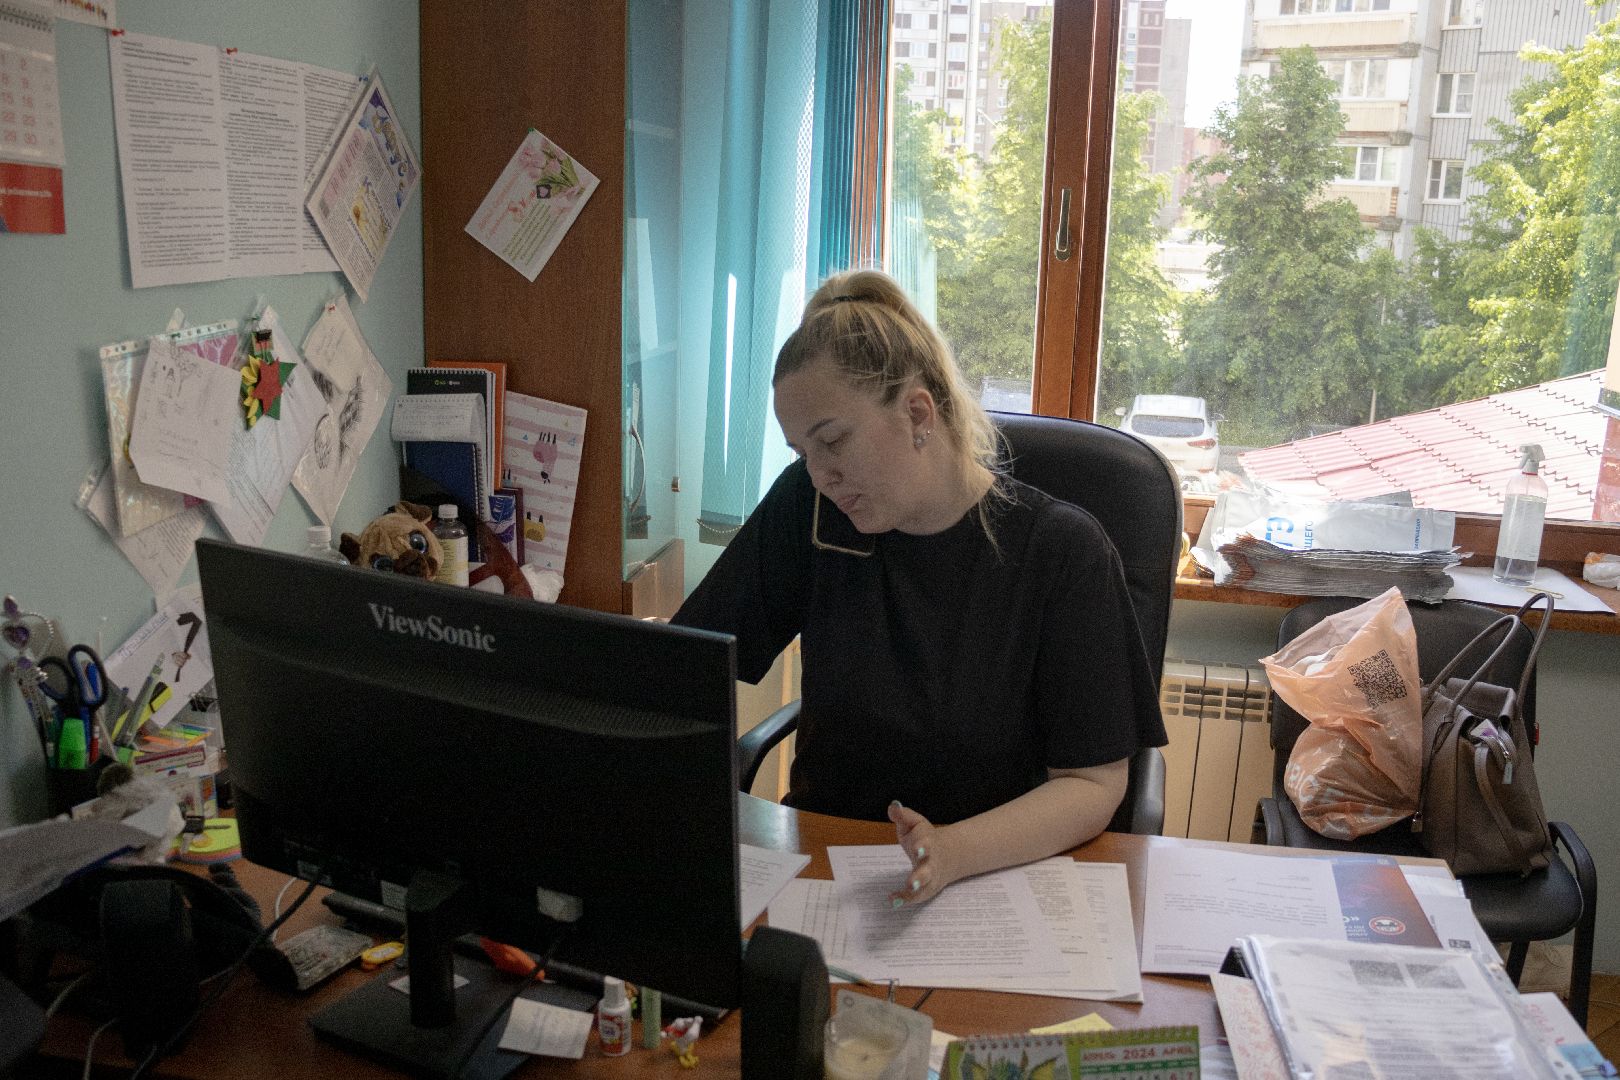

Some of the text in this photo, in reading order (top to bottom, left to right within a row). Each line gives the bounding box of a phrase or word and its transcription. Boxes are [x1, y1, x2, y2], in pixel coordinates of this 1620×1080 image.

[1304, 520, 1314, 549] ЩЕГО
[368, 602, 497, 653] ViewSonic
[1122, 1047, 1156, 1060] 2024
[1162, 1046, 1194, 1056] APRIL
